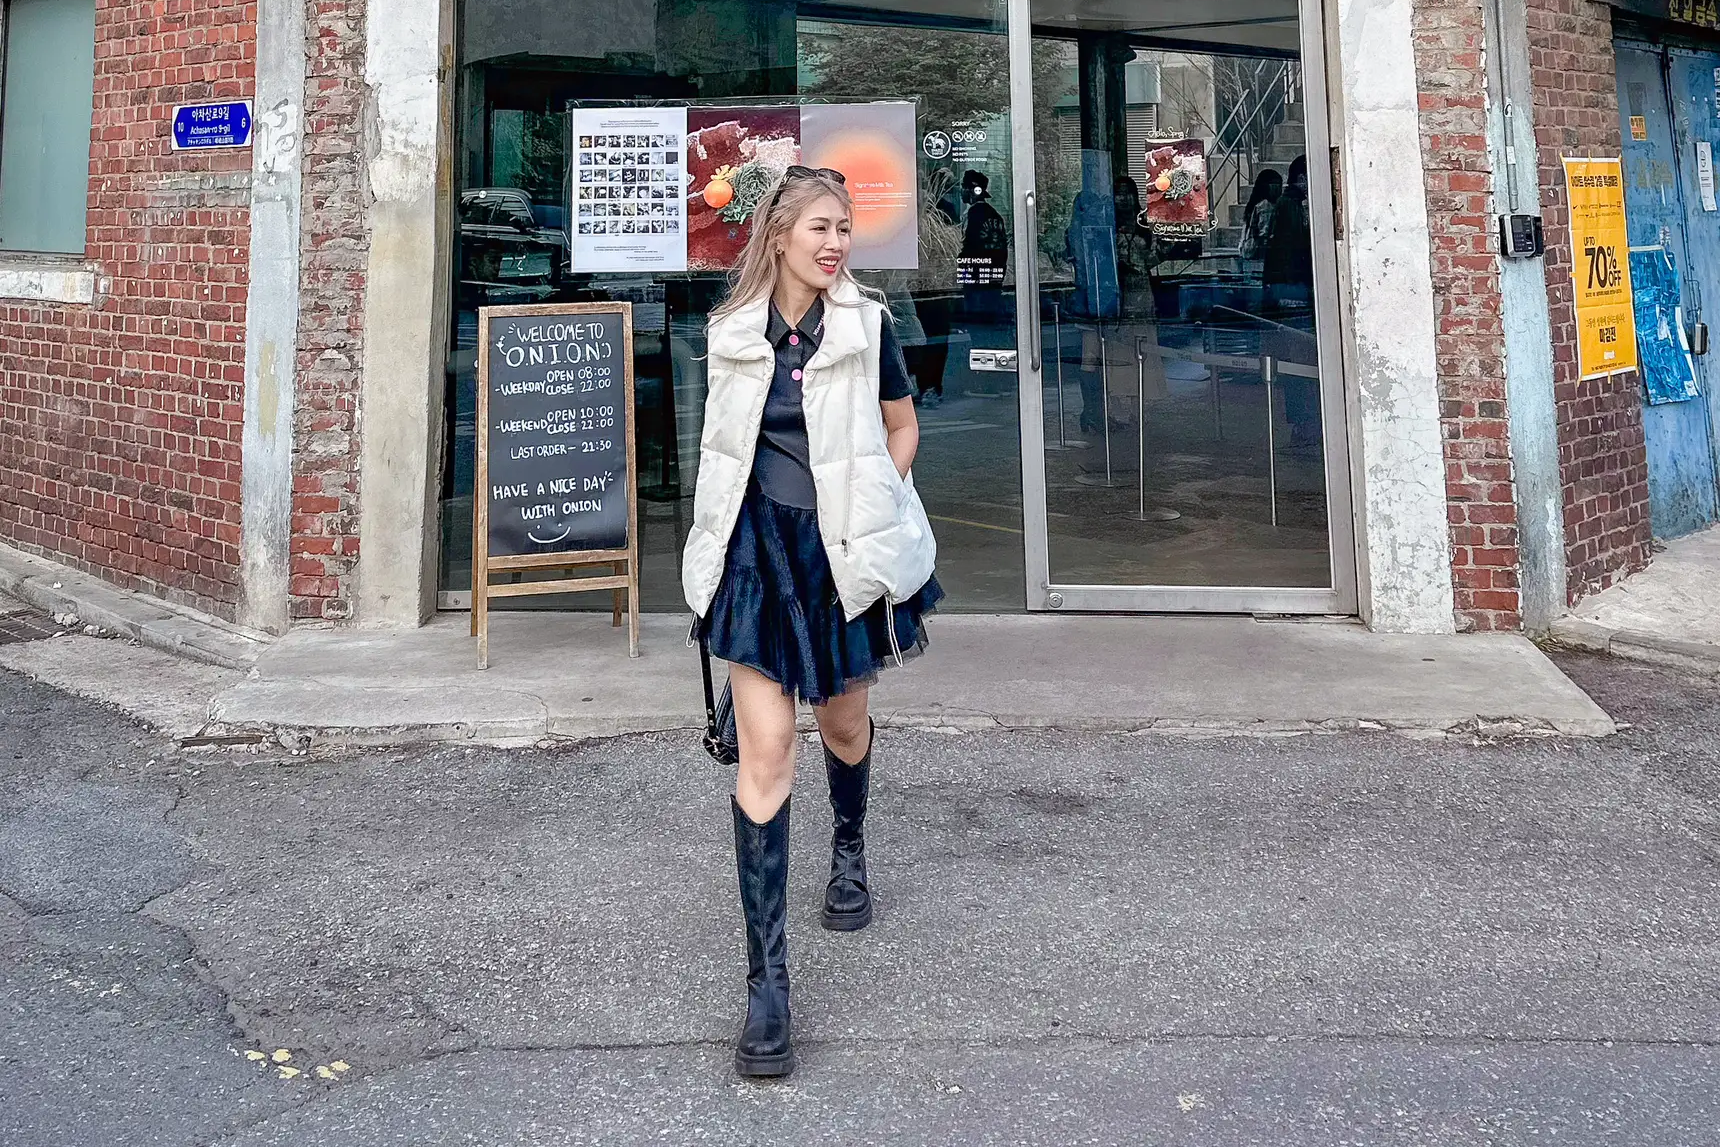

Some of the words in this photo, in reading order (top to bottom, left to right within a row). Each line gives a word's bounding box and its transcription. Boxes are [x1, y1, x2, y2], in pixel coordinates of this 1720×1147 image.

[192, 106, 230, 122] 아차산로9길
[178, 122, 184, 132] 10
[241, 118, 246, 128] 6
[1589, 236, 1595, 246] TO
[1585, 246, 1617, 289] 70%
[1608, 270, 1621, 287] OFF
[517, 324, 585, 343] WELCOME
[586, 323, 604, 339] TO
[546, 370, 574, 383] OPEN
[578, 366, 611, 379] 08:00
[546, 383, 575, 395] CLOSE
[581, 379, 611, 393] 22:00
[547, 409, 576, 422] OPEN
[580, 406, 614, 419] 10:00
[547, 422, 576, 434] CLOSE
[582, 418, 614, 430] 22:00
[511, 447, 534, 459] LAST
[537, 444, 567, 457] ORDER
[582, 440, 611, 453] 21:30
[493, 483, 528, 500] HAVE
[537, 484, 545, 496] A
[550, 478, 576, 494] NICE
[583, 476, 607, 492] DAY
[521, 504, 556, 520] WITH
[563, 500, 602, 515] ONION
